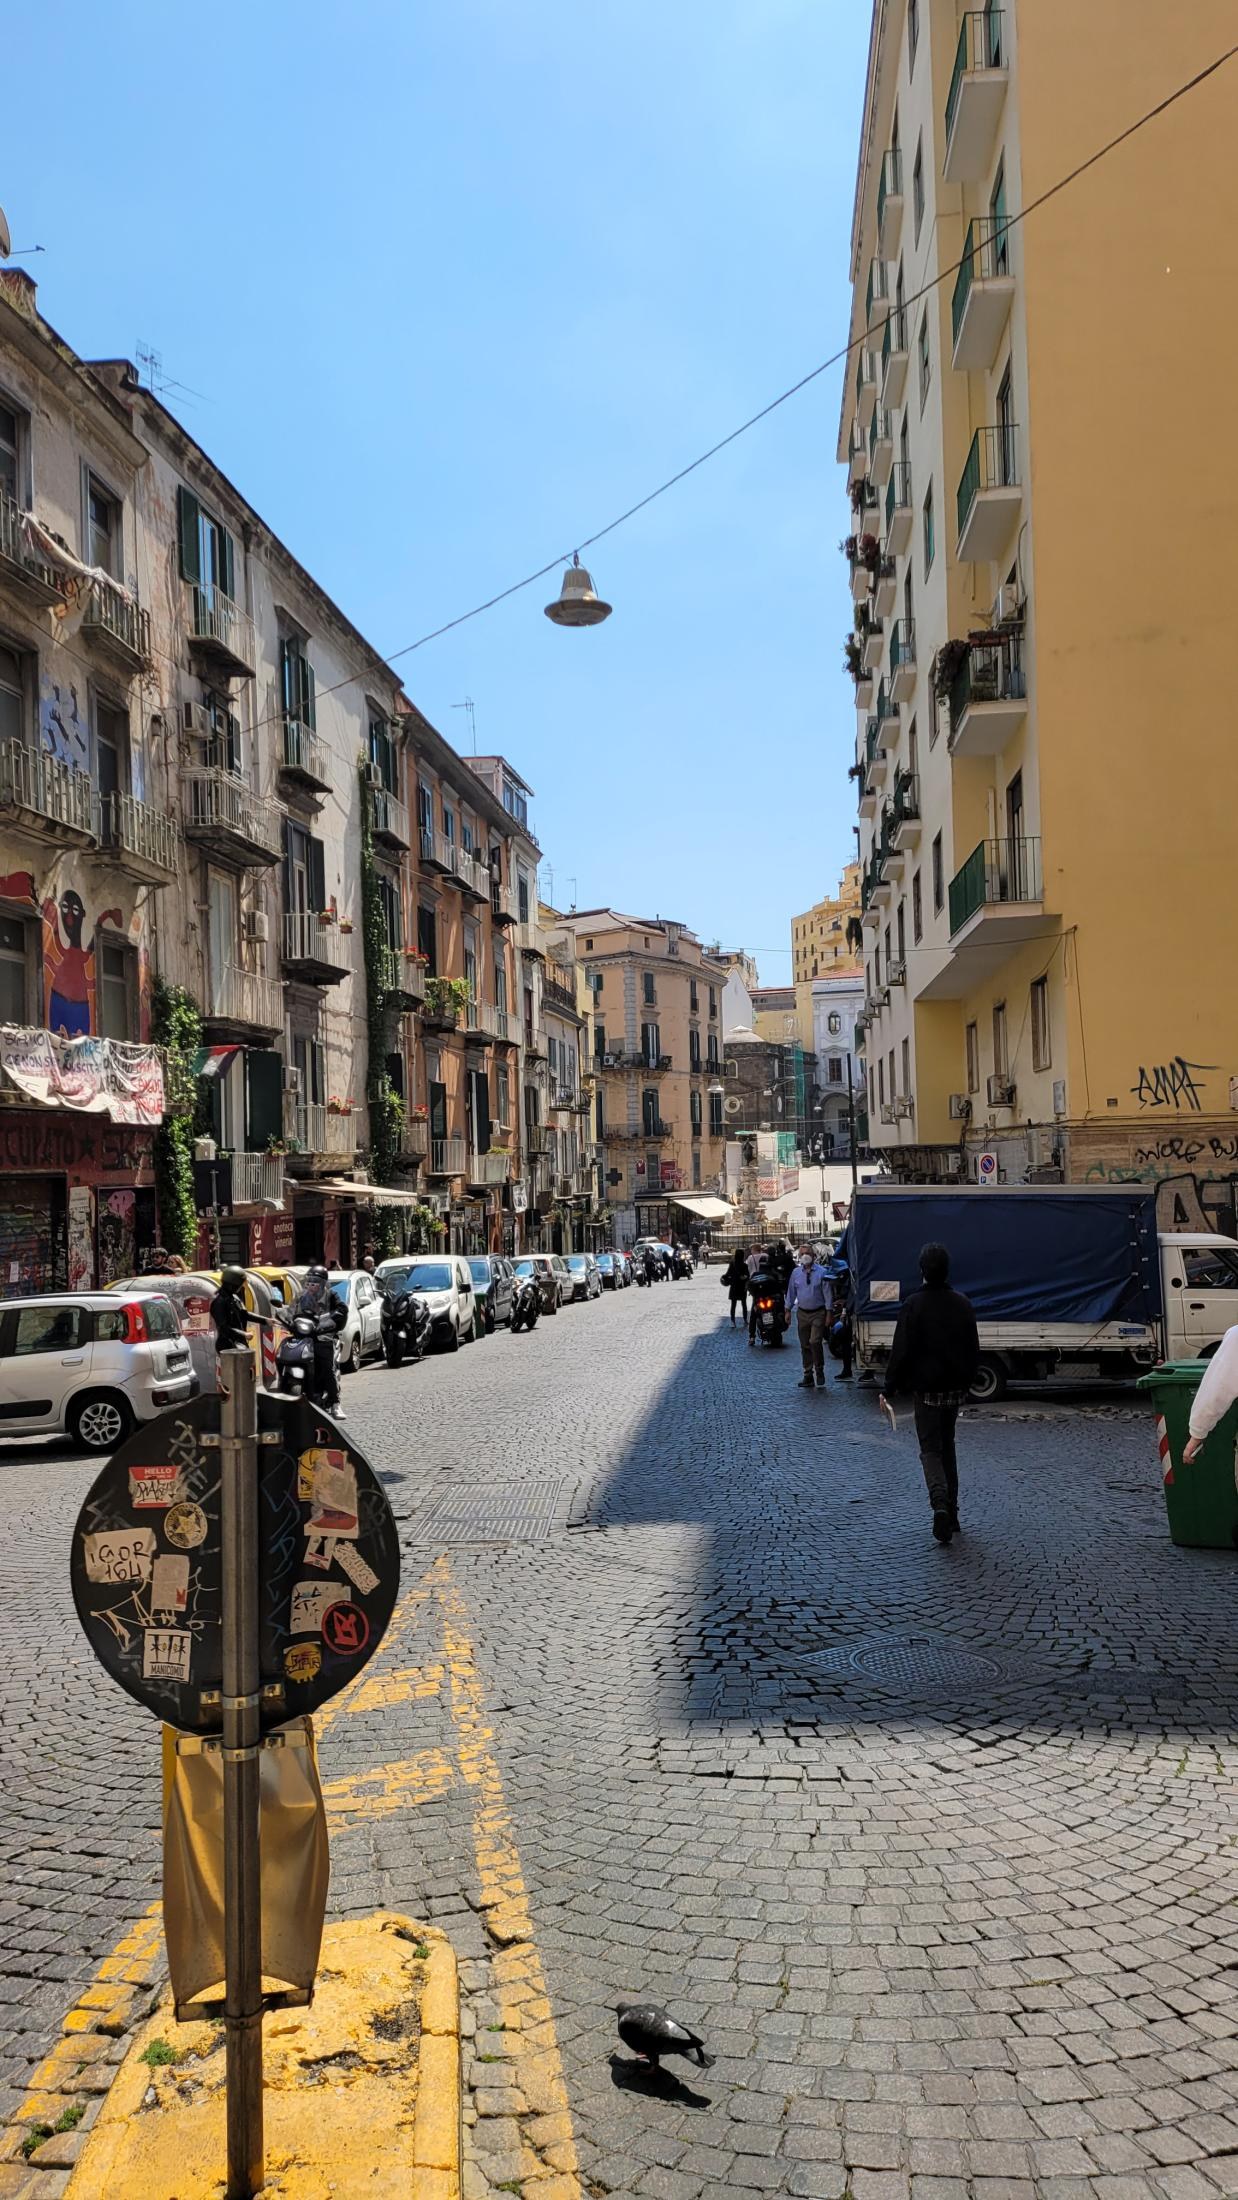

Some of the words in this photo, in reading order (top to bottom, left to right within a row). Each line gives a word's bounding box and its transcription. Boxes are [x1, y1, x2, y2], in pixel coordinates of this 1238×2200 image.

[273, 1222, 294, 1234] enoteca
[274, 1234, 293, 1249] vineria
[144, 1467, 172, 1475] HELLO
[151, 1664, 184, 1677] MANICOMIO
